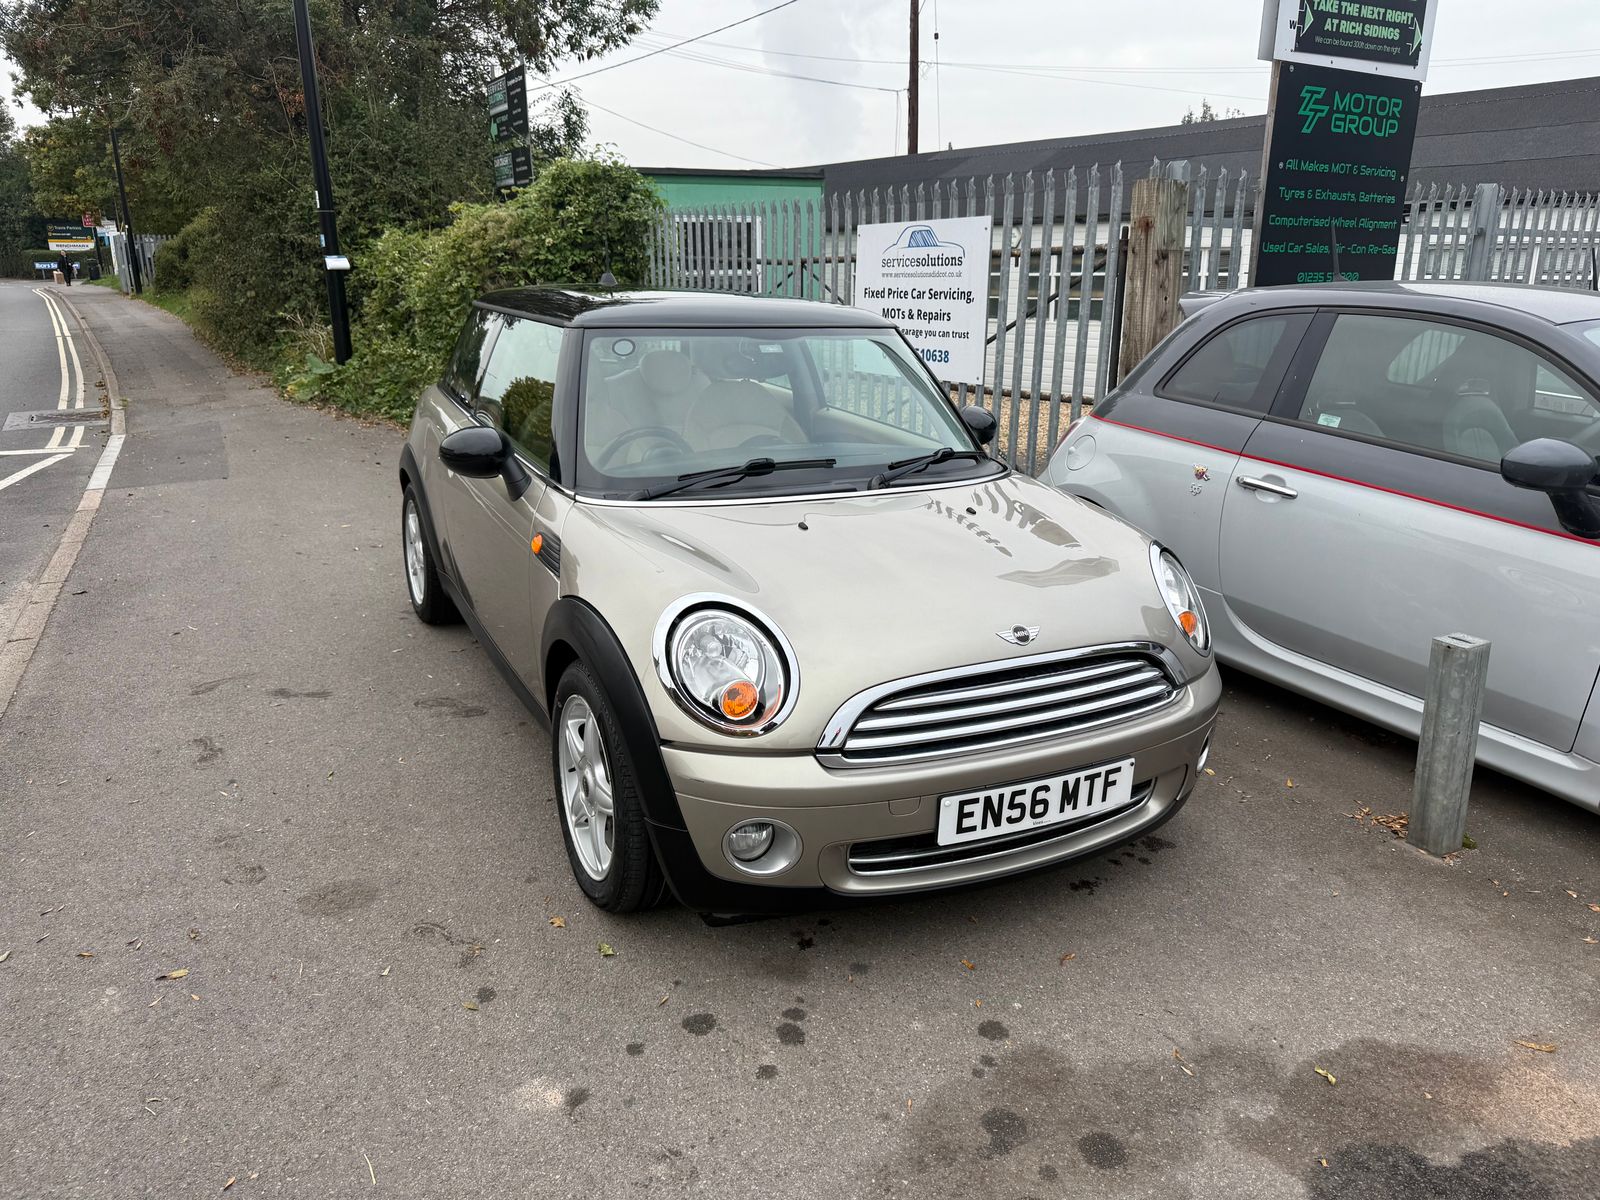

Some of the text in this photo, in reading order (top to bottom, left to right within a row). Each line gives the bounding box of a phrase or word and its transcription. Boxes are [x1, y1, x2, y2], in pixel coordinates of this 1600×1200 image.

[1313, 0, 1414, 25] TAKE THE NEXT RIGHT
[1324, 17, 1400, 41] AT RICH SIDINGS
[1315, 35, 1323, 43] We
[1333, 38, 1340, 46] be
[1339, 38, 1353, 48] found
[1364, 42, 1376, 51] down
[1390, 46, 1401, 55] right
[1333, 91, 1403, 117] MOTOR
[1331, 113, 1399, 137] GROUP
[1286, 159, 1397, 180] All Makes MOT & Servicing
[1279, 187, 1396, 204] Tyres & Exhausts, Batteries
[1268, 214, 1398, 231] Computerised Wheel Alignment
[1262, 242, 1286, 253] Used
[1288, 242, 1304, 253] Car
[1305, 242, 1330, 254] Sales,
[1367, 244, 1396, 255] Re-Gas
[881, 253, 963, 268] servicesolutions
[881, 270, 963, 279] www.servicesolutionsdidcot.co.uk
[1297, 271, 1325, 283] 01235
[863, 287, 975, 304] Fixed Price Car Servicing,
[881, 307, 951, 324] MOTs & Repairs
[924, 329, 937, 339] you
[938, 330, 950, 338] can
[952, 330, 970, 339] trust
[914, 347, 949, 363] 10638
[955, 766, 1122, 835] EN56 MTF
